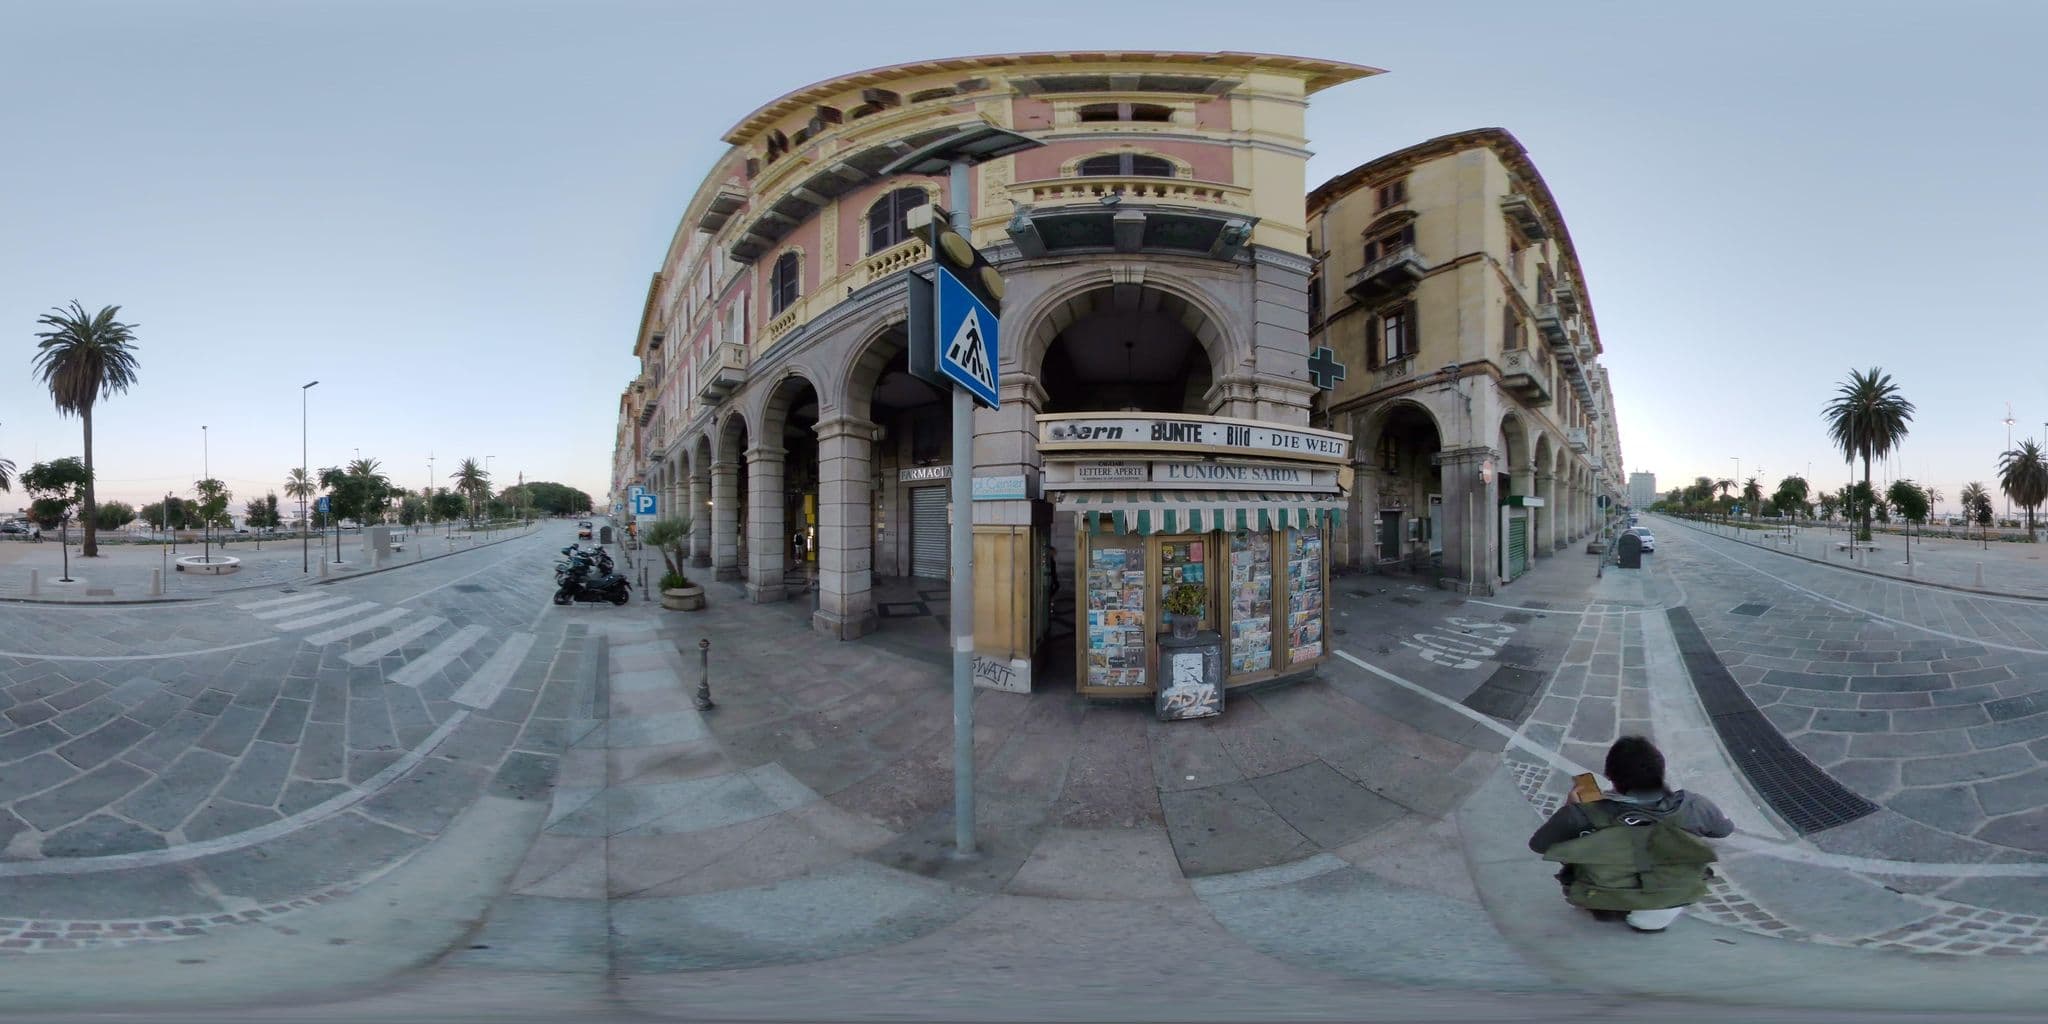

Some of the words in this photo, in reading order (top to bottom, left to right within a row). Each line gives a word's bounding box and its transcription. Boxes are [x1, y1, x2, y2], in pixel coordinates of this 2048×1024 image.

[1151, 422, 1203, 443] BUNTE
[1227, 425, 1251, 447] Bild
[1272, 434, 1300, 449] DIE
[1305, 438, 1343, 453] WELT
[901, 466, 953, 480] FARMACIA
[1079, 467, 1113, 476] LETTERE
[1113, 467, 1143, 476] APERTE
[1169, 464, 1246, 480] L'UNIONE
[1251, 467, 1300, 482] SARDA
[640, 497, 653, 512] P
